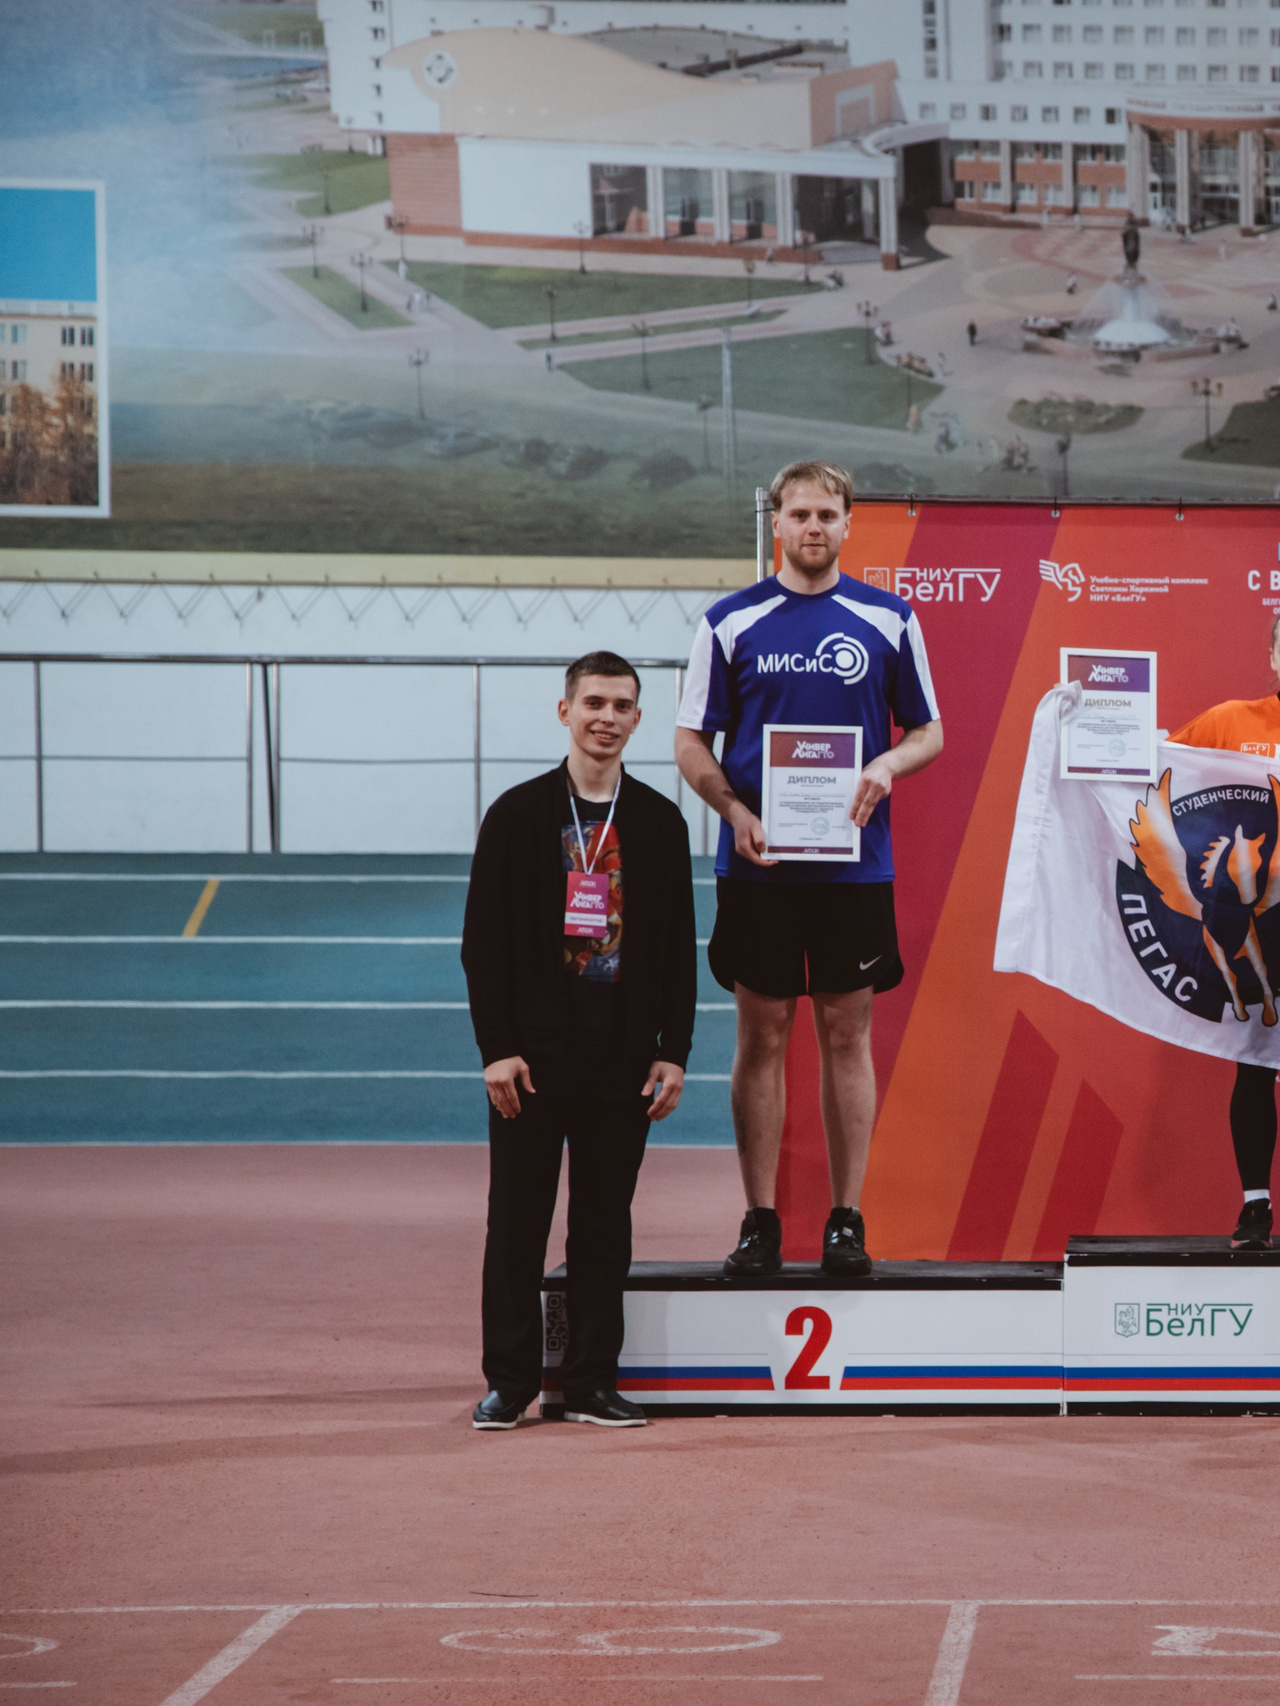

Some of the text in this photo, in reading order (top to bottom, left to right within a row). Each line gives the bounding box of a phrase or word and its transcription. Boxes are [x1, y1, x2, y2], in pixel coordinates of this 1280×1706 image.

[895, 573, 1001, 602] БелГУ
[915, 568, 953, 582] НИУ
[757, 653, 833, 674] МИСиС
[1084, 698, 1132, 708] ДИПЛОМ
[787, 775, 837, 785] ДИПЛОМ
[1172, 788, 1270, 817] СТУДЕНЧЕСКИЙ
[1121, 893, 1198, 1001] ПЕГАС
[1167, 1303, 1206, 1316] НИУ
[1146, 1308, 1253, 1337] БелГУ
[784, 1305, 833, 1390] 2
